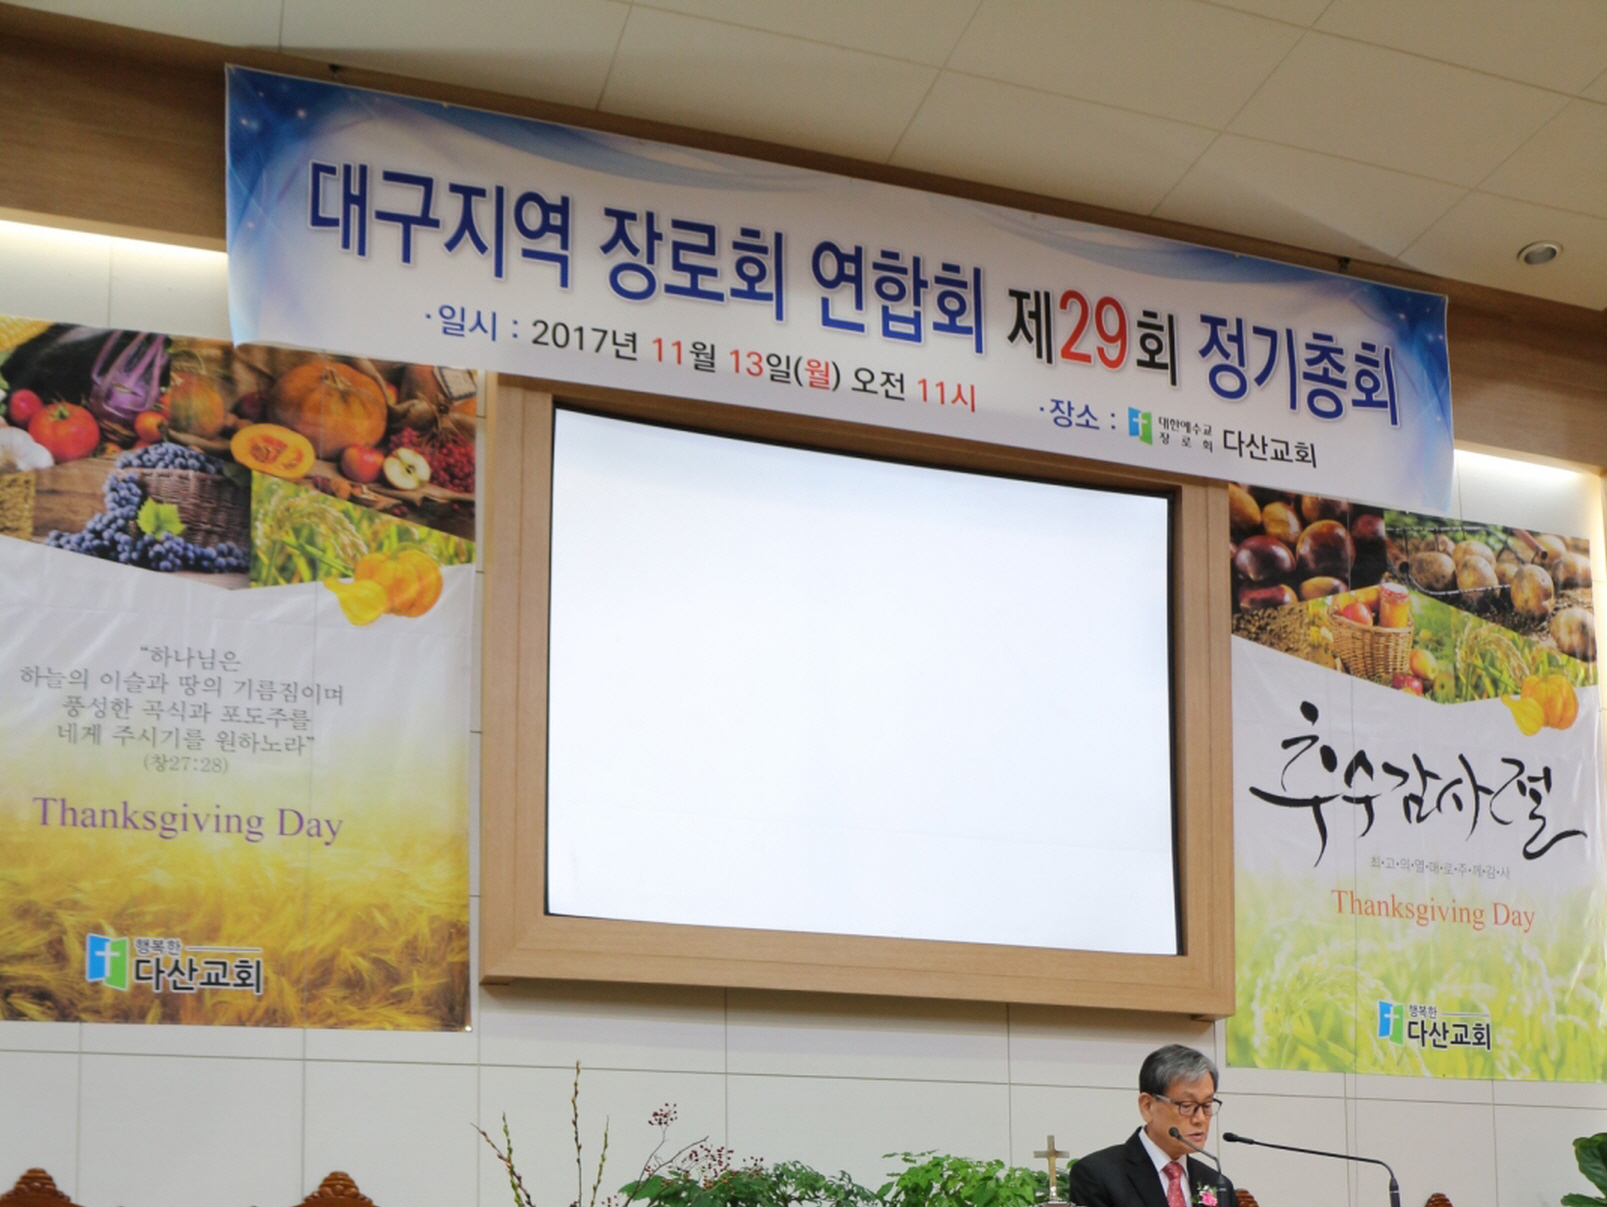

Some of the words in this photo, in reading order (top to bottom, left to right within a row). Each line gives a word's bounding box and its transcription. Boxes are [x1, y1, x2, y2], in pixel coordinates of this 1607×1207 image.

[310, 161, 571, 290] 대구지역
[600, 206, 785, 323] 장로회
[810, 239, 986, 355] 연합회
[1006, 286, 1180, 387] 제29회
[1199, 312, 1401, 427] 정기총회
[531, 319, 638, 361] 2017년
[652, 337, 716, 373] 11월
[730, 348, 841, 392] 13일(월)
[851, 367, 906, 401] 오전
[917, 378, 976, 413] 11시
[1158, 416, 1213, 436] 대한예수교
[1223, 429, 1317, 469] 다산교회
[20, 665, 90, 691] 하늘의
[100, 670, 169, 695] 이슬과
[179, 675, 222, 697] 땅의
[233, 678, 344, 706] 기름짐이며
[62, 694, 133, 720] 풍성한
[142, 700, 211, 725] 곡식과
[220, 704, 312, 731] 포도주를
[57, 723, 102, 746] 네게
[112, 725, 206, 751] 주시기를
[1249, 700, 1588, 868] 추수감사절
[32, 796, 265, 842] Thanksgiving
[277, 808, 344, 847] Day
[1331, 889, 1485, 931] Thanksgiving
[1493, 902, 1535, 933] Day
[135, 938, 182, 956] 행복한
[134, 957, 263, 994] 다산교회
[1408, 1004, 1437, 1019] 행복한
[1407, 1020, 1491, 1050] 다산교회
